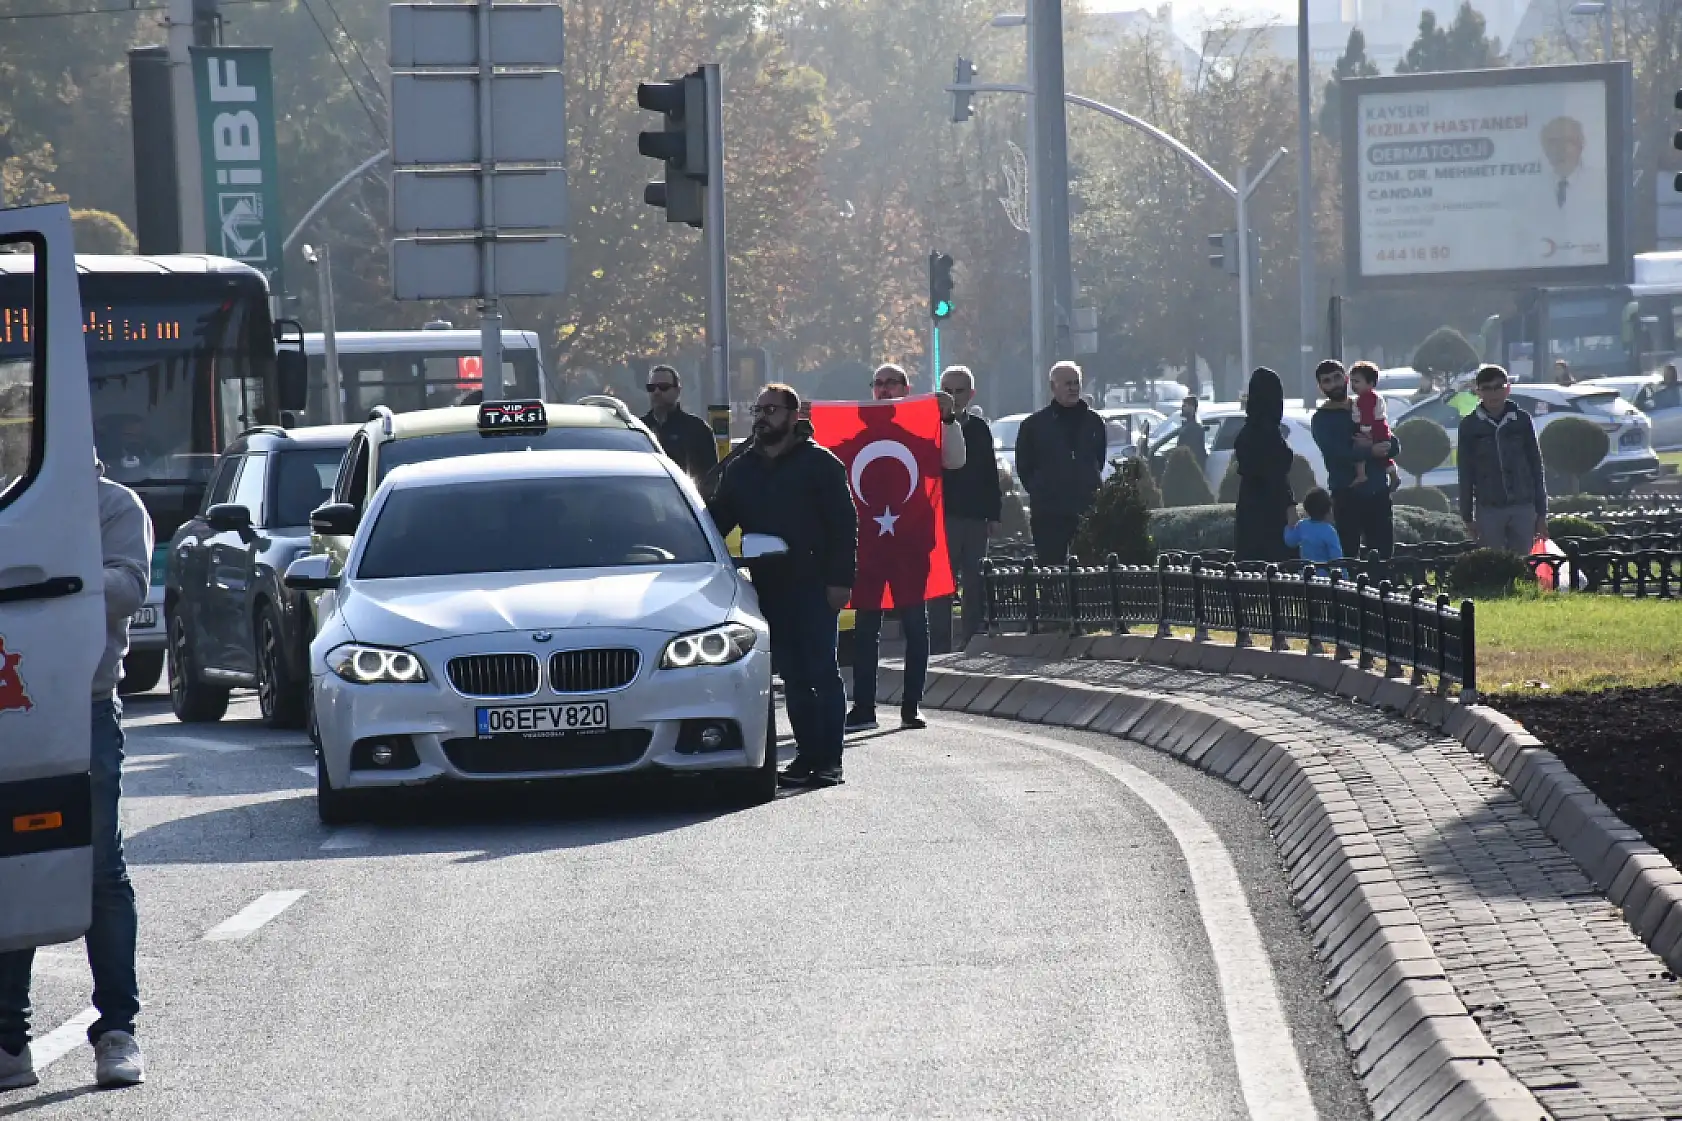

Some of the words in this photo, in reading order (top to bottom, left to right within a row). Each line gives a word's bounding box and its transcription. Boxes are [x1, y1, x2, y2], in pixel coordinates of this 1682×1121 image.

[1366, 121, 1430, 137] KIZILAY
[1433, 110, 1528, 133] HASTANESİ
[1434, 165, 1497, 179] MEHMET
[489, 705, 605, 730] 06EFV820
